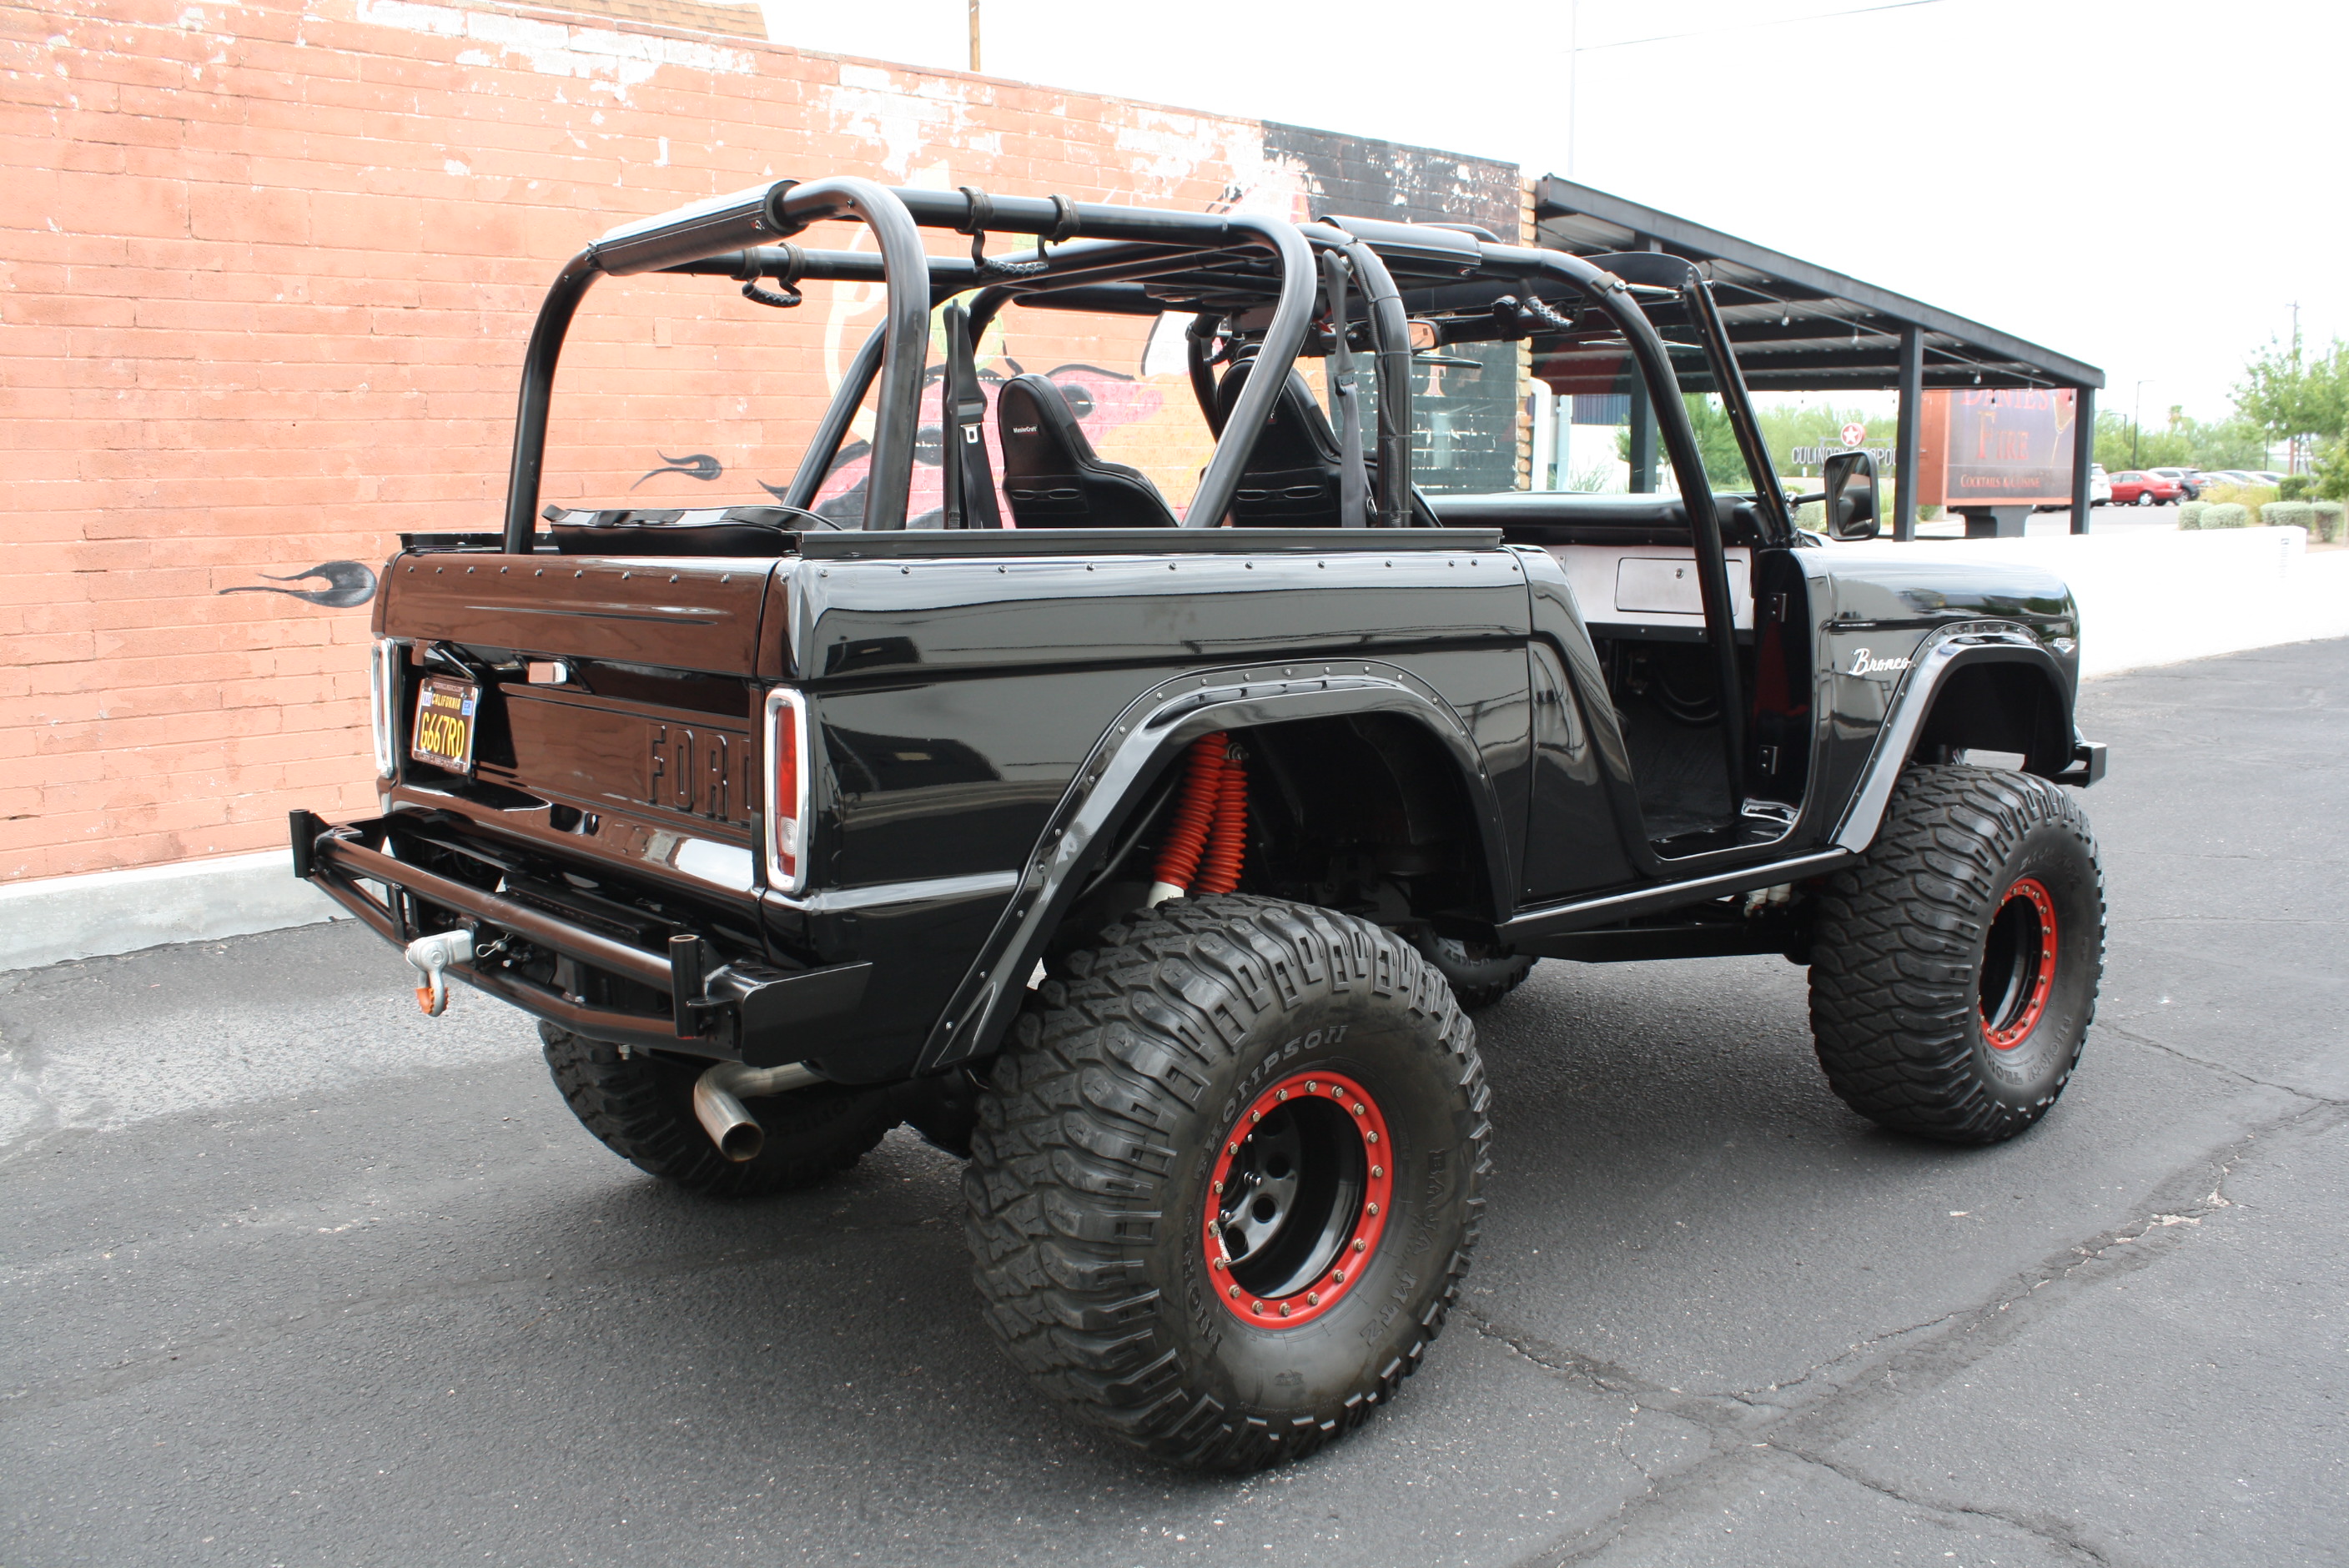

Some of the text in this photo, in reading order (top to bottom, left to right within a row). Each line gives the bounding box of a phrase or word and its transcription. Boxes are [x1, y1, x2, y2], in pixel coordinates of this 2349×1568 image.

[1977, 410, 2029, 460] FIRE
[1961, 473, 2000, 488] COCKTAILS
[1847, 647, 1912, 676] Bronco
[431, 693, 461, 710] CALIFORNIA
